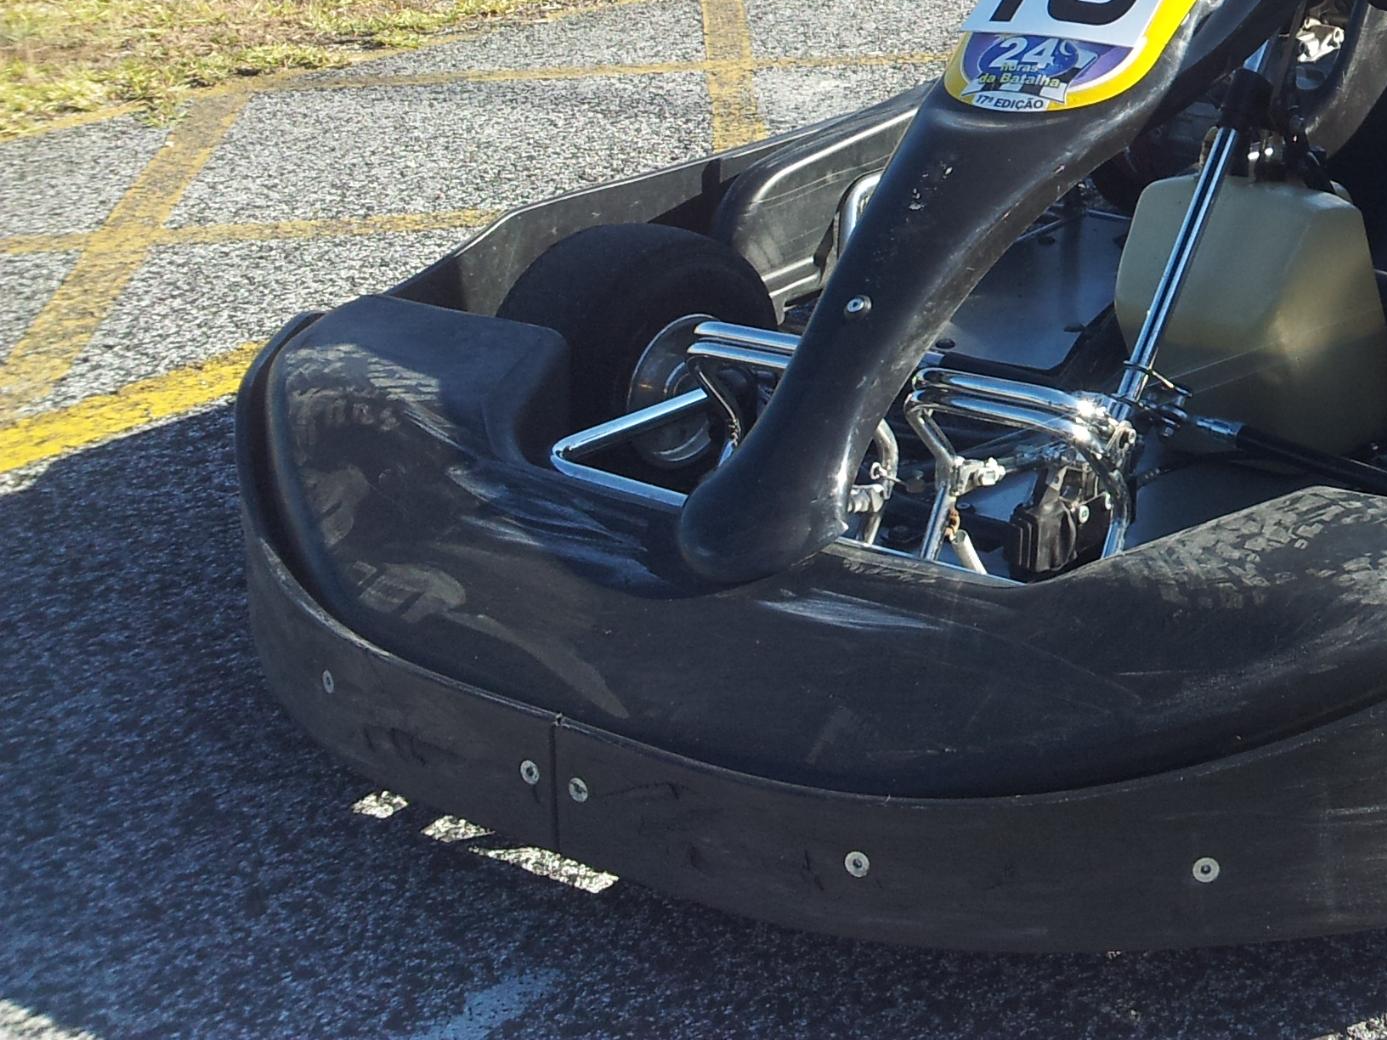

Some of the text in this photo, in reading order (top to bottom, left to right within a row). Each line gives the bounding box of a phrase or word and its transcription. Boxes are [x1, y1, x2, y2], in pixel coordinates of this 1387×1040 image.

[989, 36, 1060, 69] 24
[978, 72, 1061, 88] da Batalha
[993, 97, 1044, 110] EDIÇÃO
